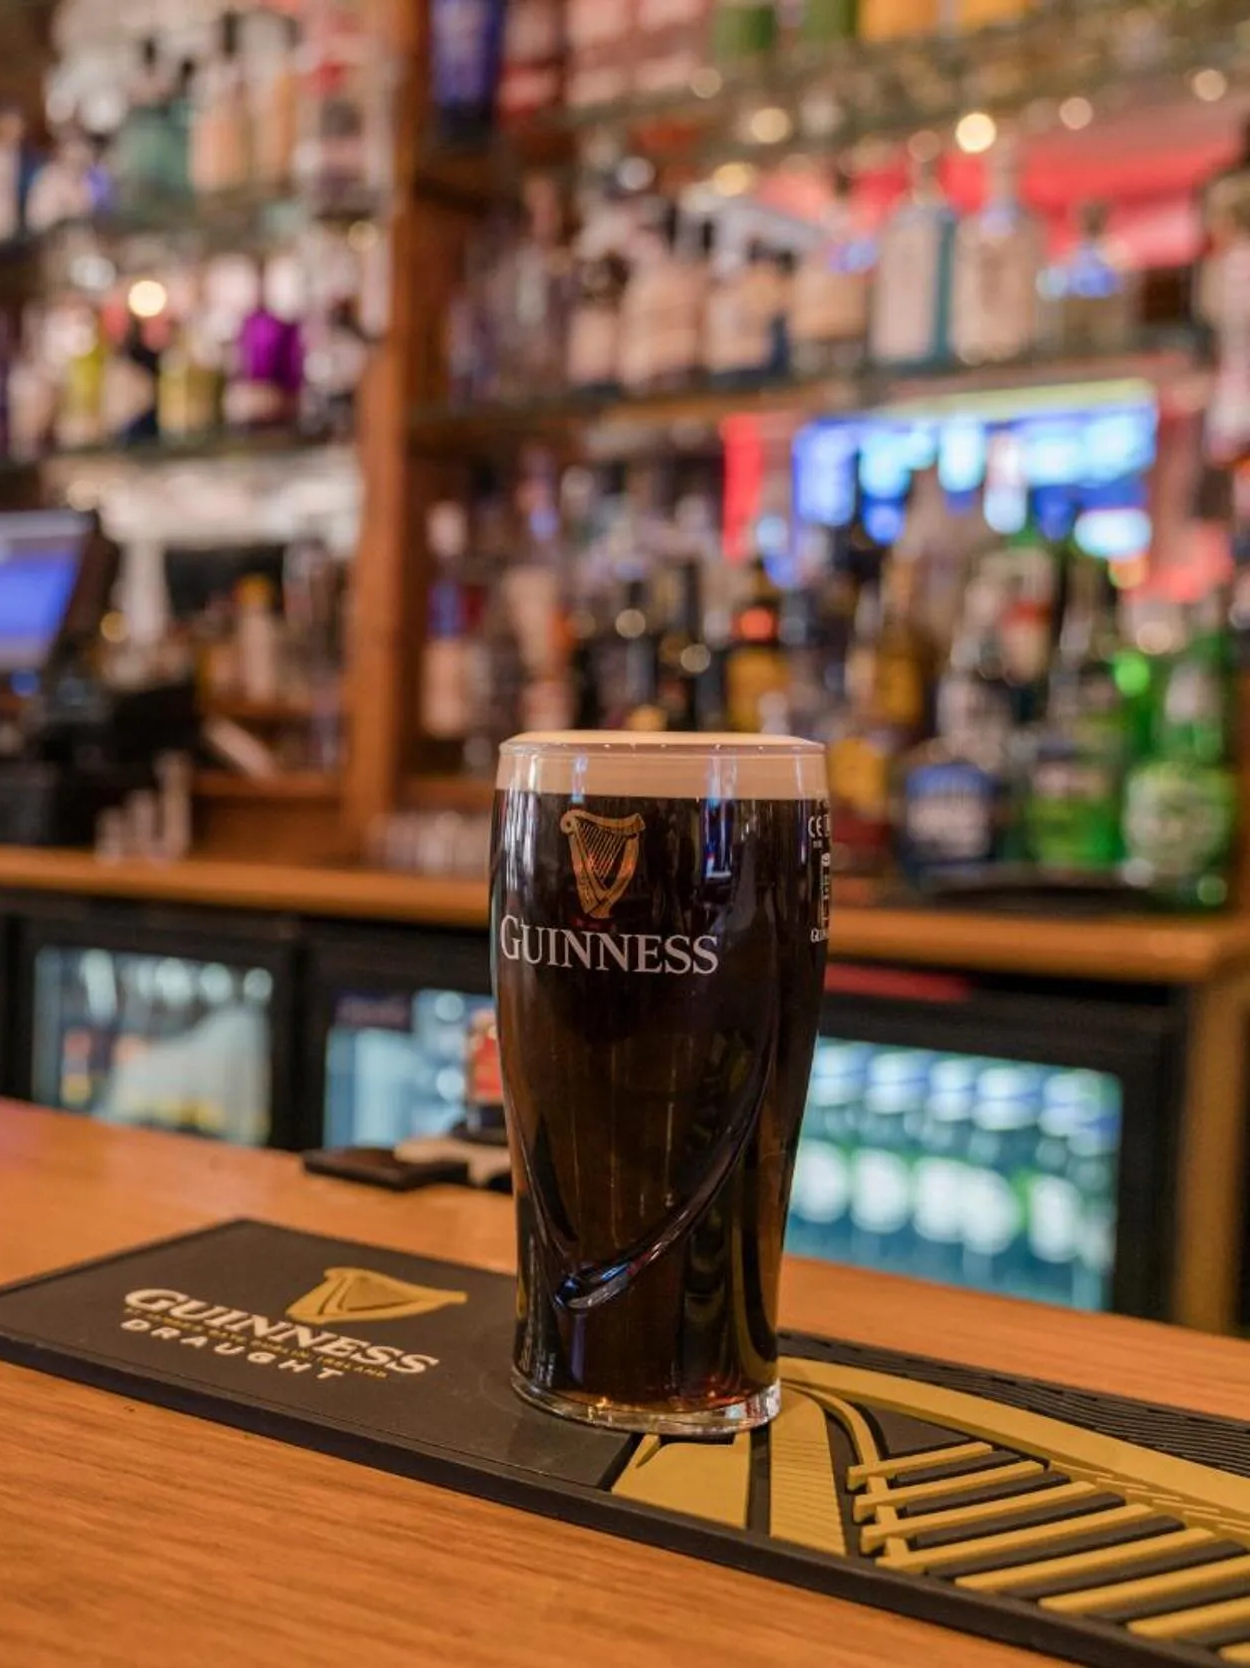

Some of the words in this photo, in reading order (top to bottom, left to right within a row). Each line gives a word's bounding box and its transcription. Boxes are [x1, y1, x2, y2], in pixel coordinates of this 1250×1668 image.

[500, 914, 719, 975] GUINNESS
[120, 1318, 345, 1379] DRAUGHT
[124, 1288, 440, 1375] GUINNESS
